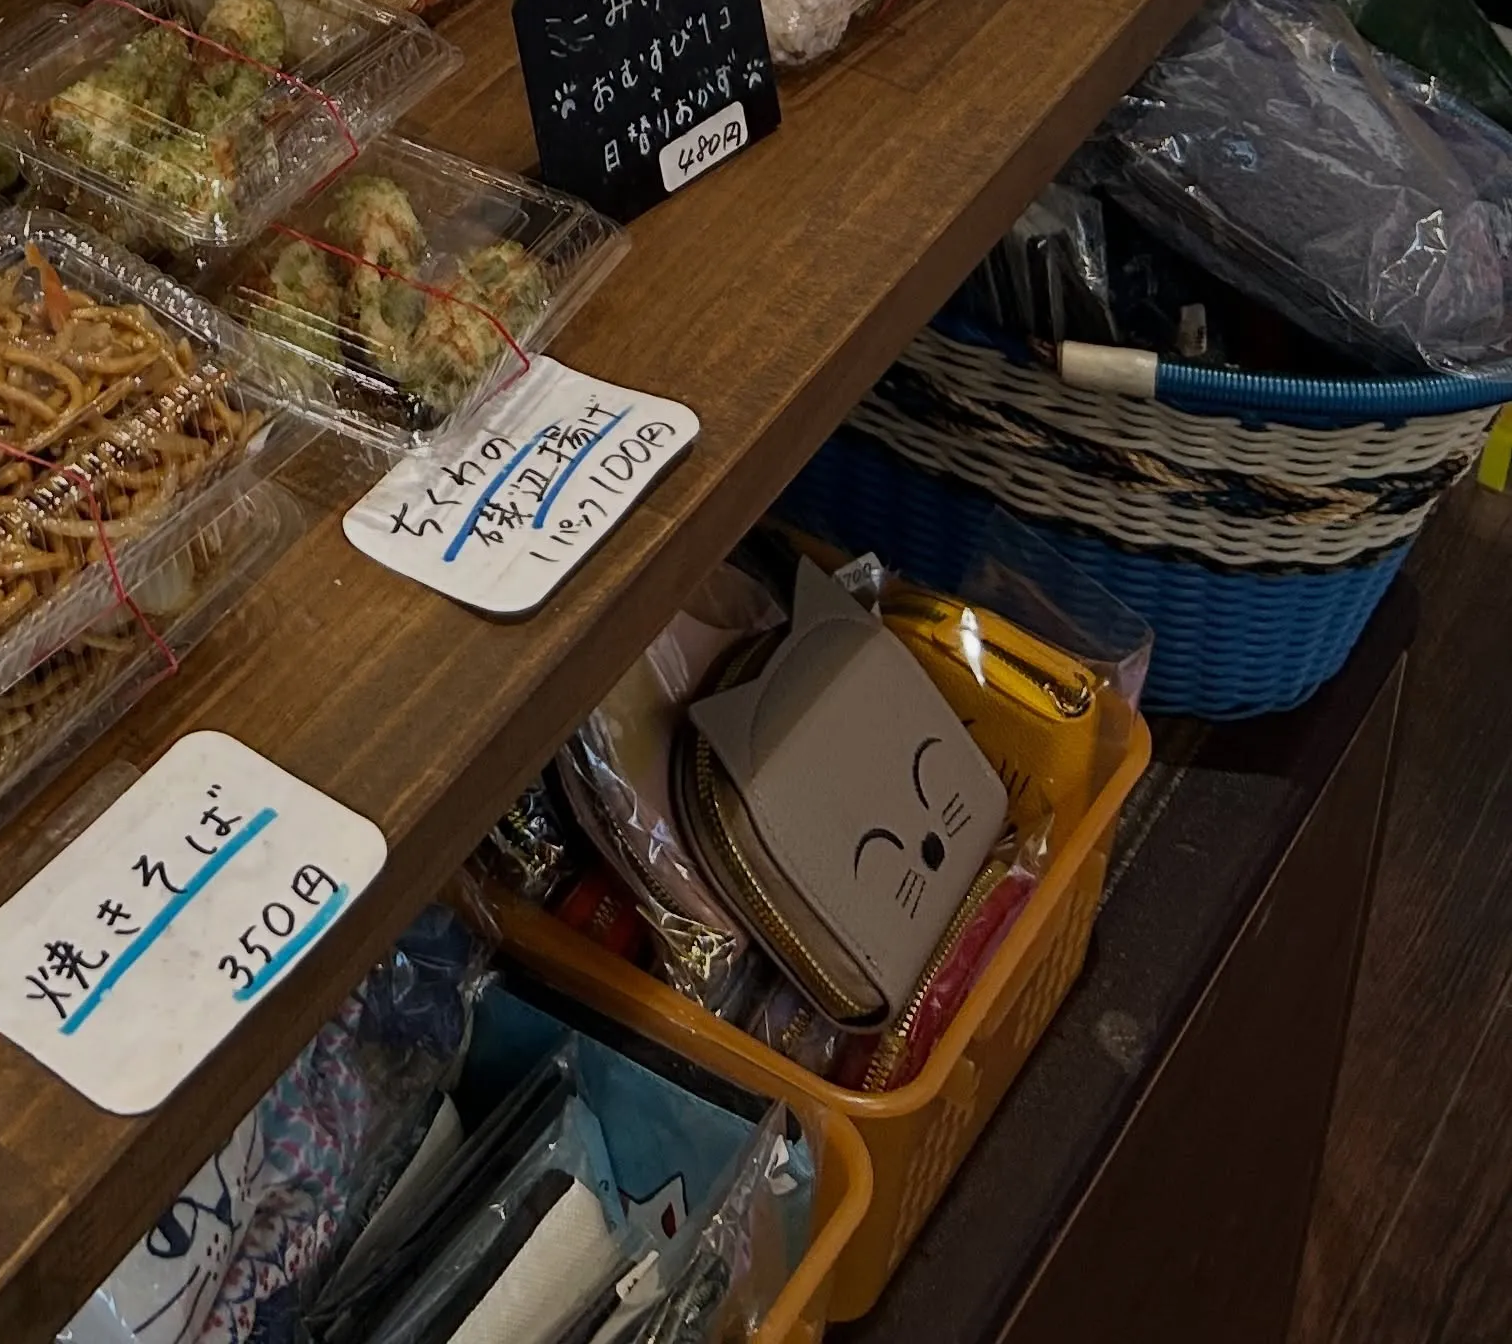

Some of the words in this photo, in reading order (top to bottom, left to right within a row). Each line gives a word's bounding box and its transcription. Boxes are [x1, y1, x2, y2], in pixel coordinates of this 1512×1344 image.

[592, 4, 733, 112] おむすび1コ
[678, 119, 742, 176] 480円
[389, 437, 517, 537] ちくわの
[589, 421, 677, 494] 100円
[25, 784, 244, 1019] 焼きそば
[218, 864, 340, 990] 350円
